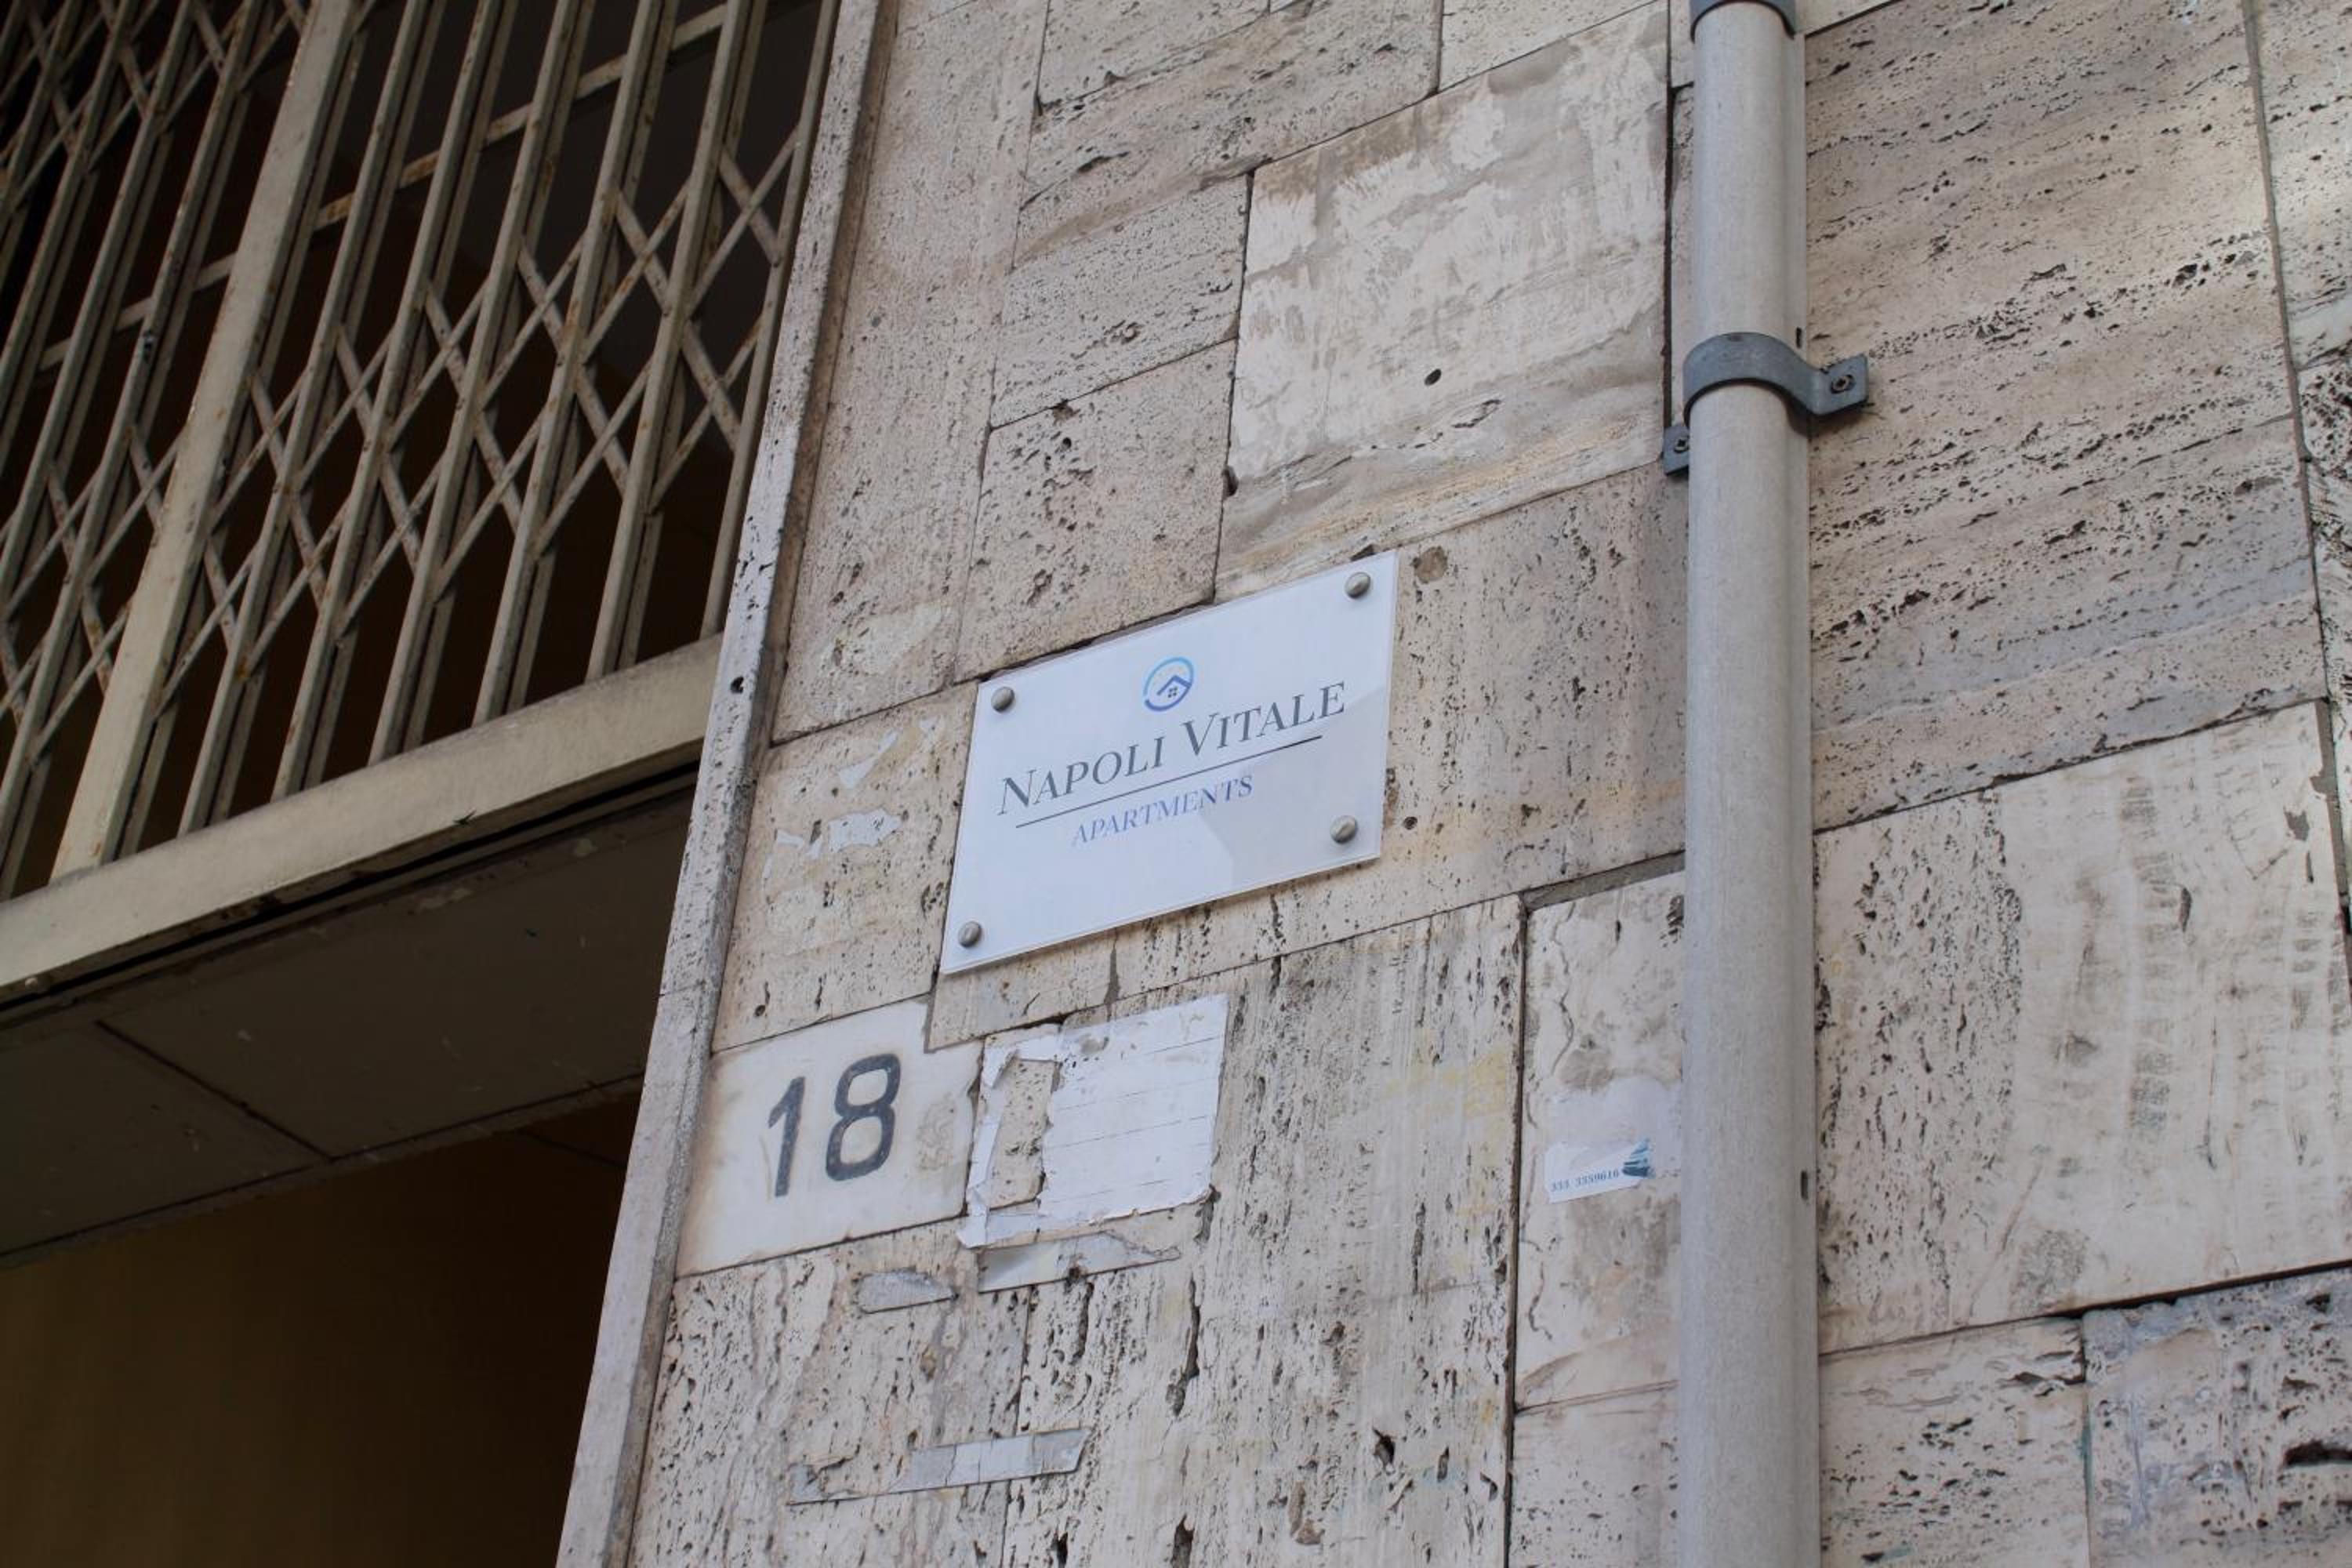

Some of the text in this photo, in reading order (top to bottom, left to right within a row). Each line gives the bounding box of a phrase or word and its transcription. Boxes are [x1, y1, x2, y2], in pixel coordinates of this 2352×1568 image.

[997, 681, 1346, 815] NAPOLI VITALE
[1071, 775, 1254, 847] APARTMENTS
[768, 1053, 902, 1198] 18
